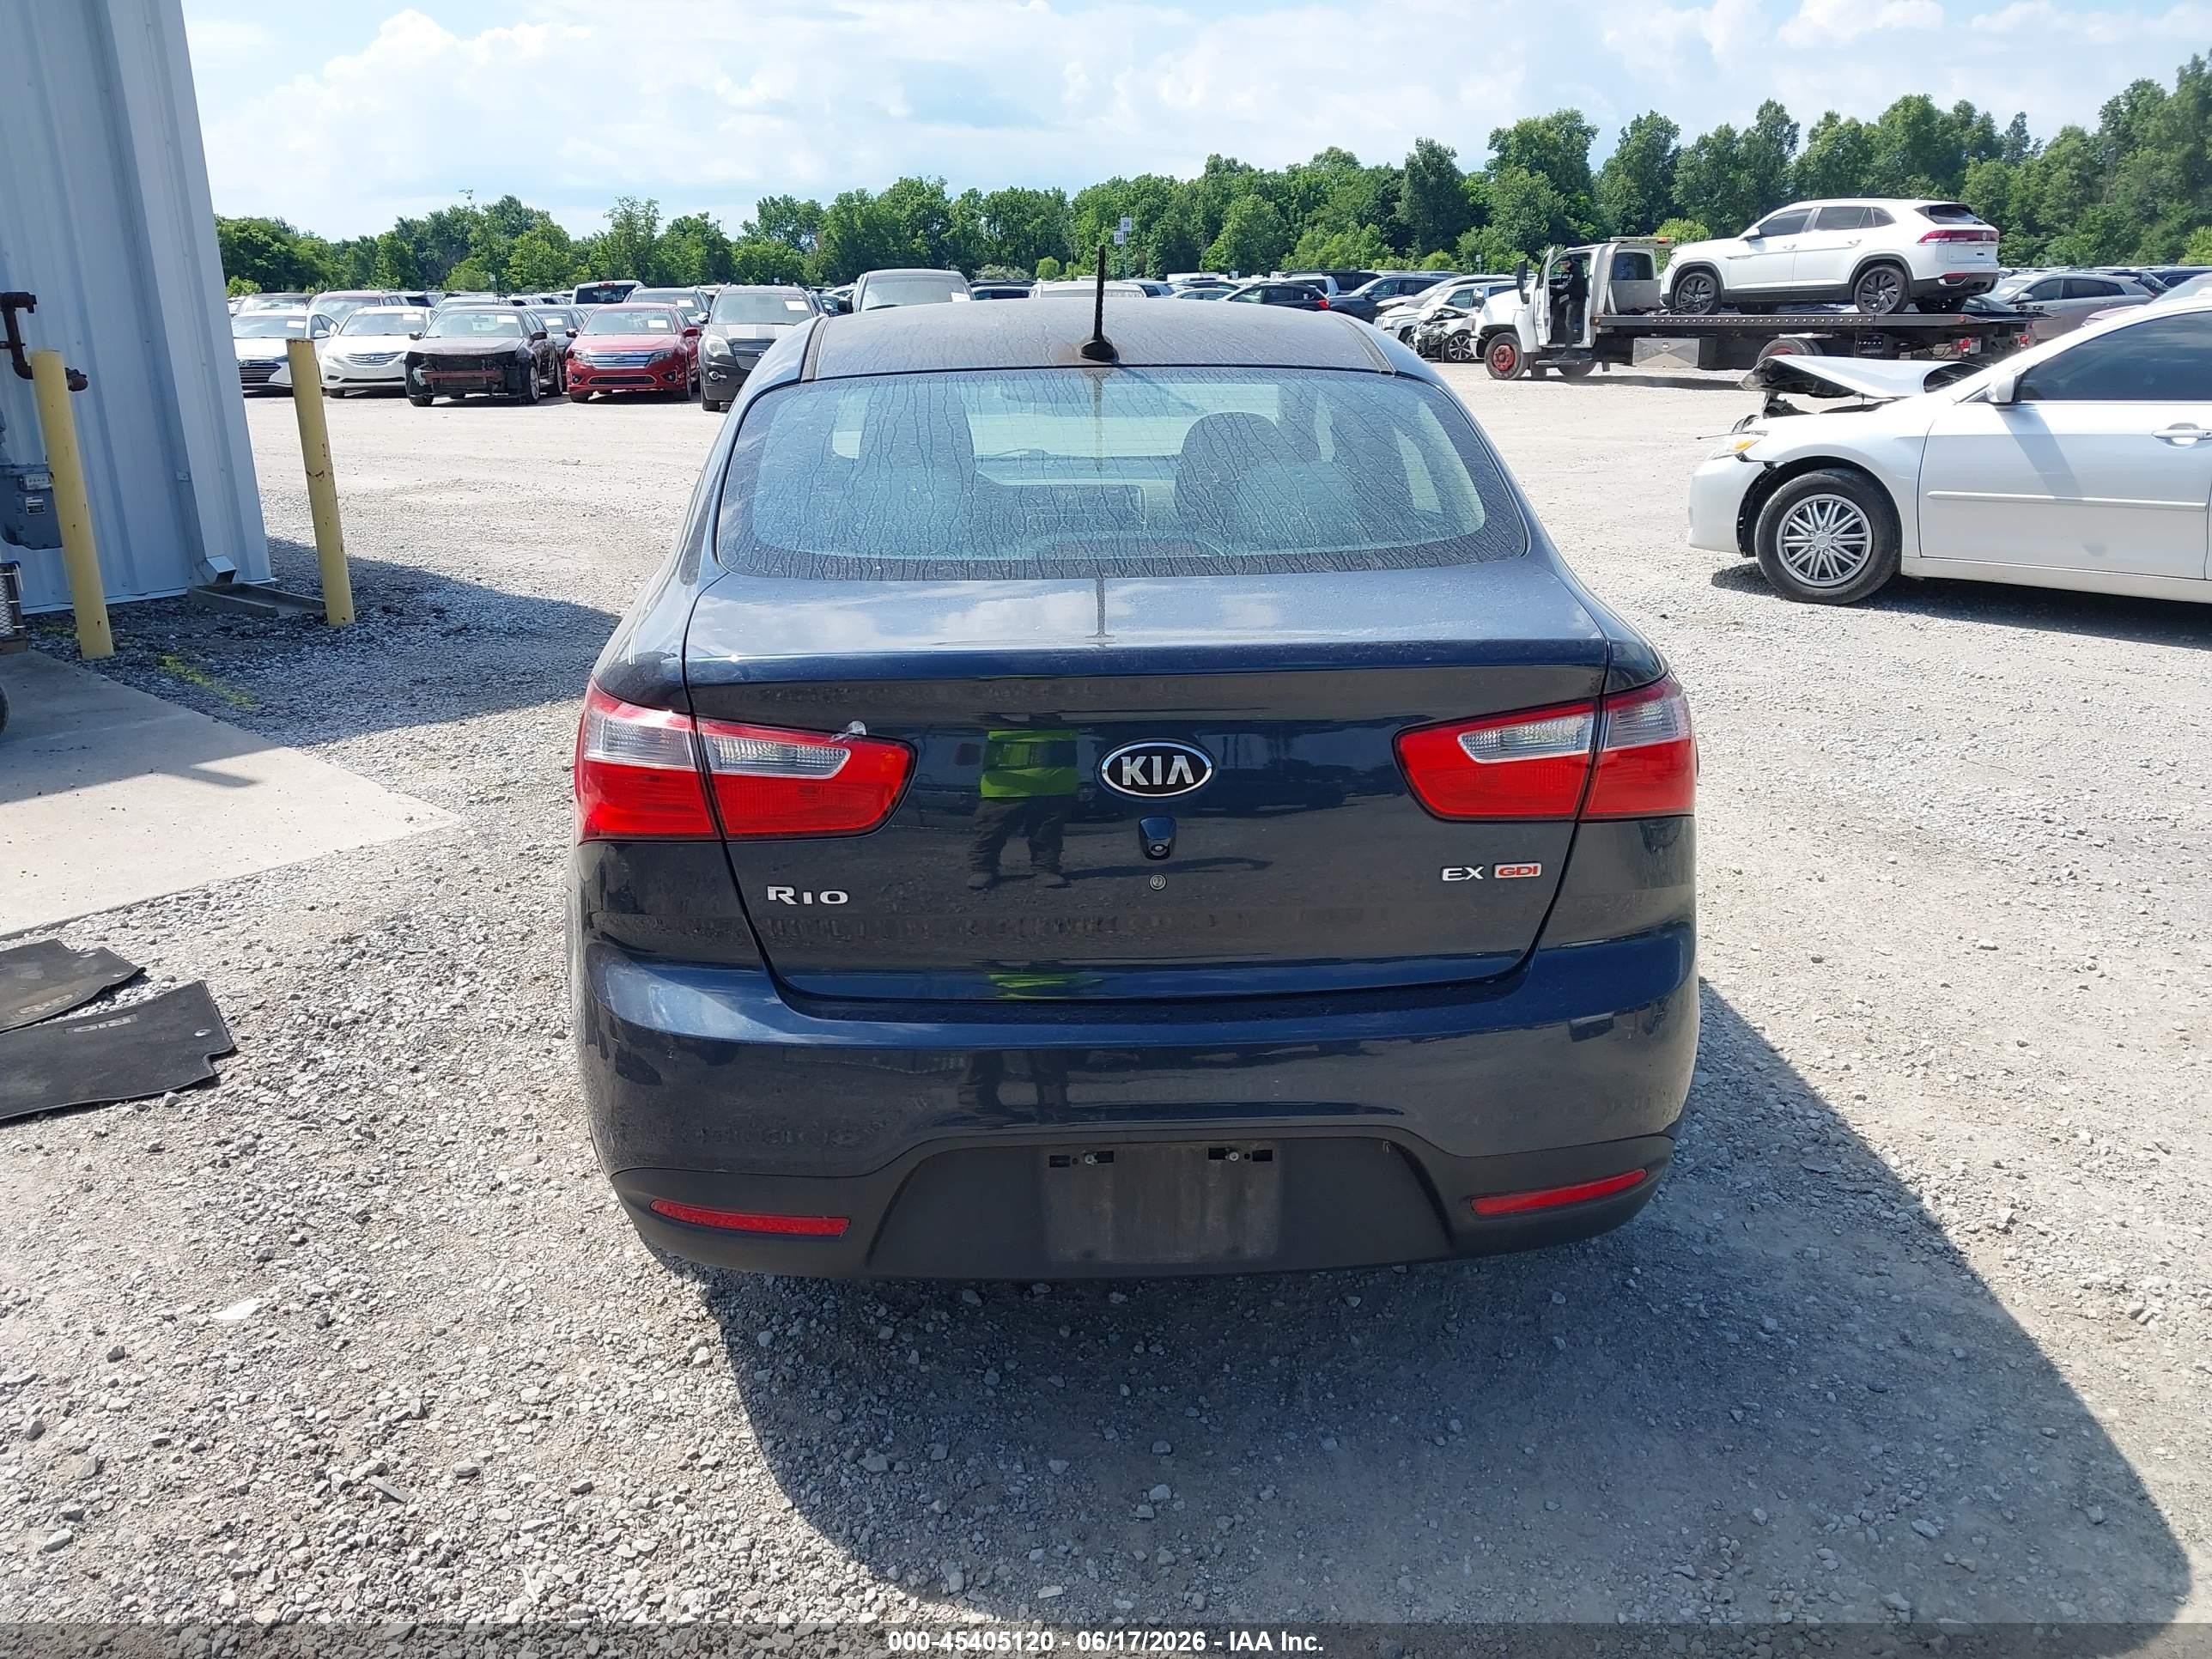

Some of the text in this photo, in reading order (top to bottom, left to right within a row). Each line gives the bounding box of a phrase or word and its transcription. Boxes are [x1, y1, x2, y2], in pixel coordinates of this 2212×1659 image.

[1115, 234, 1123, 242] 20
[1121, 755, 1194, 786] KIA
[1442, 865, 1539, 882] EX GDI
